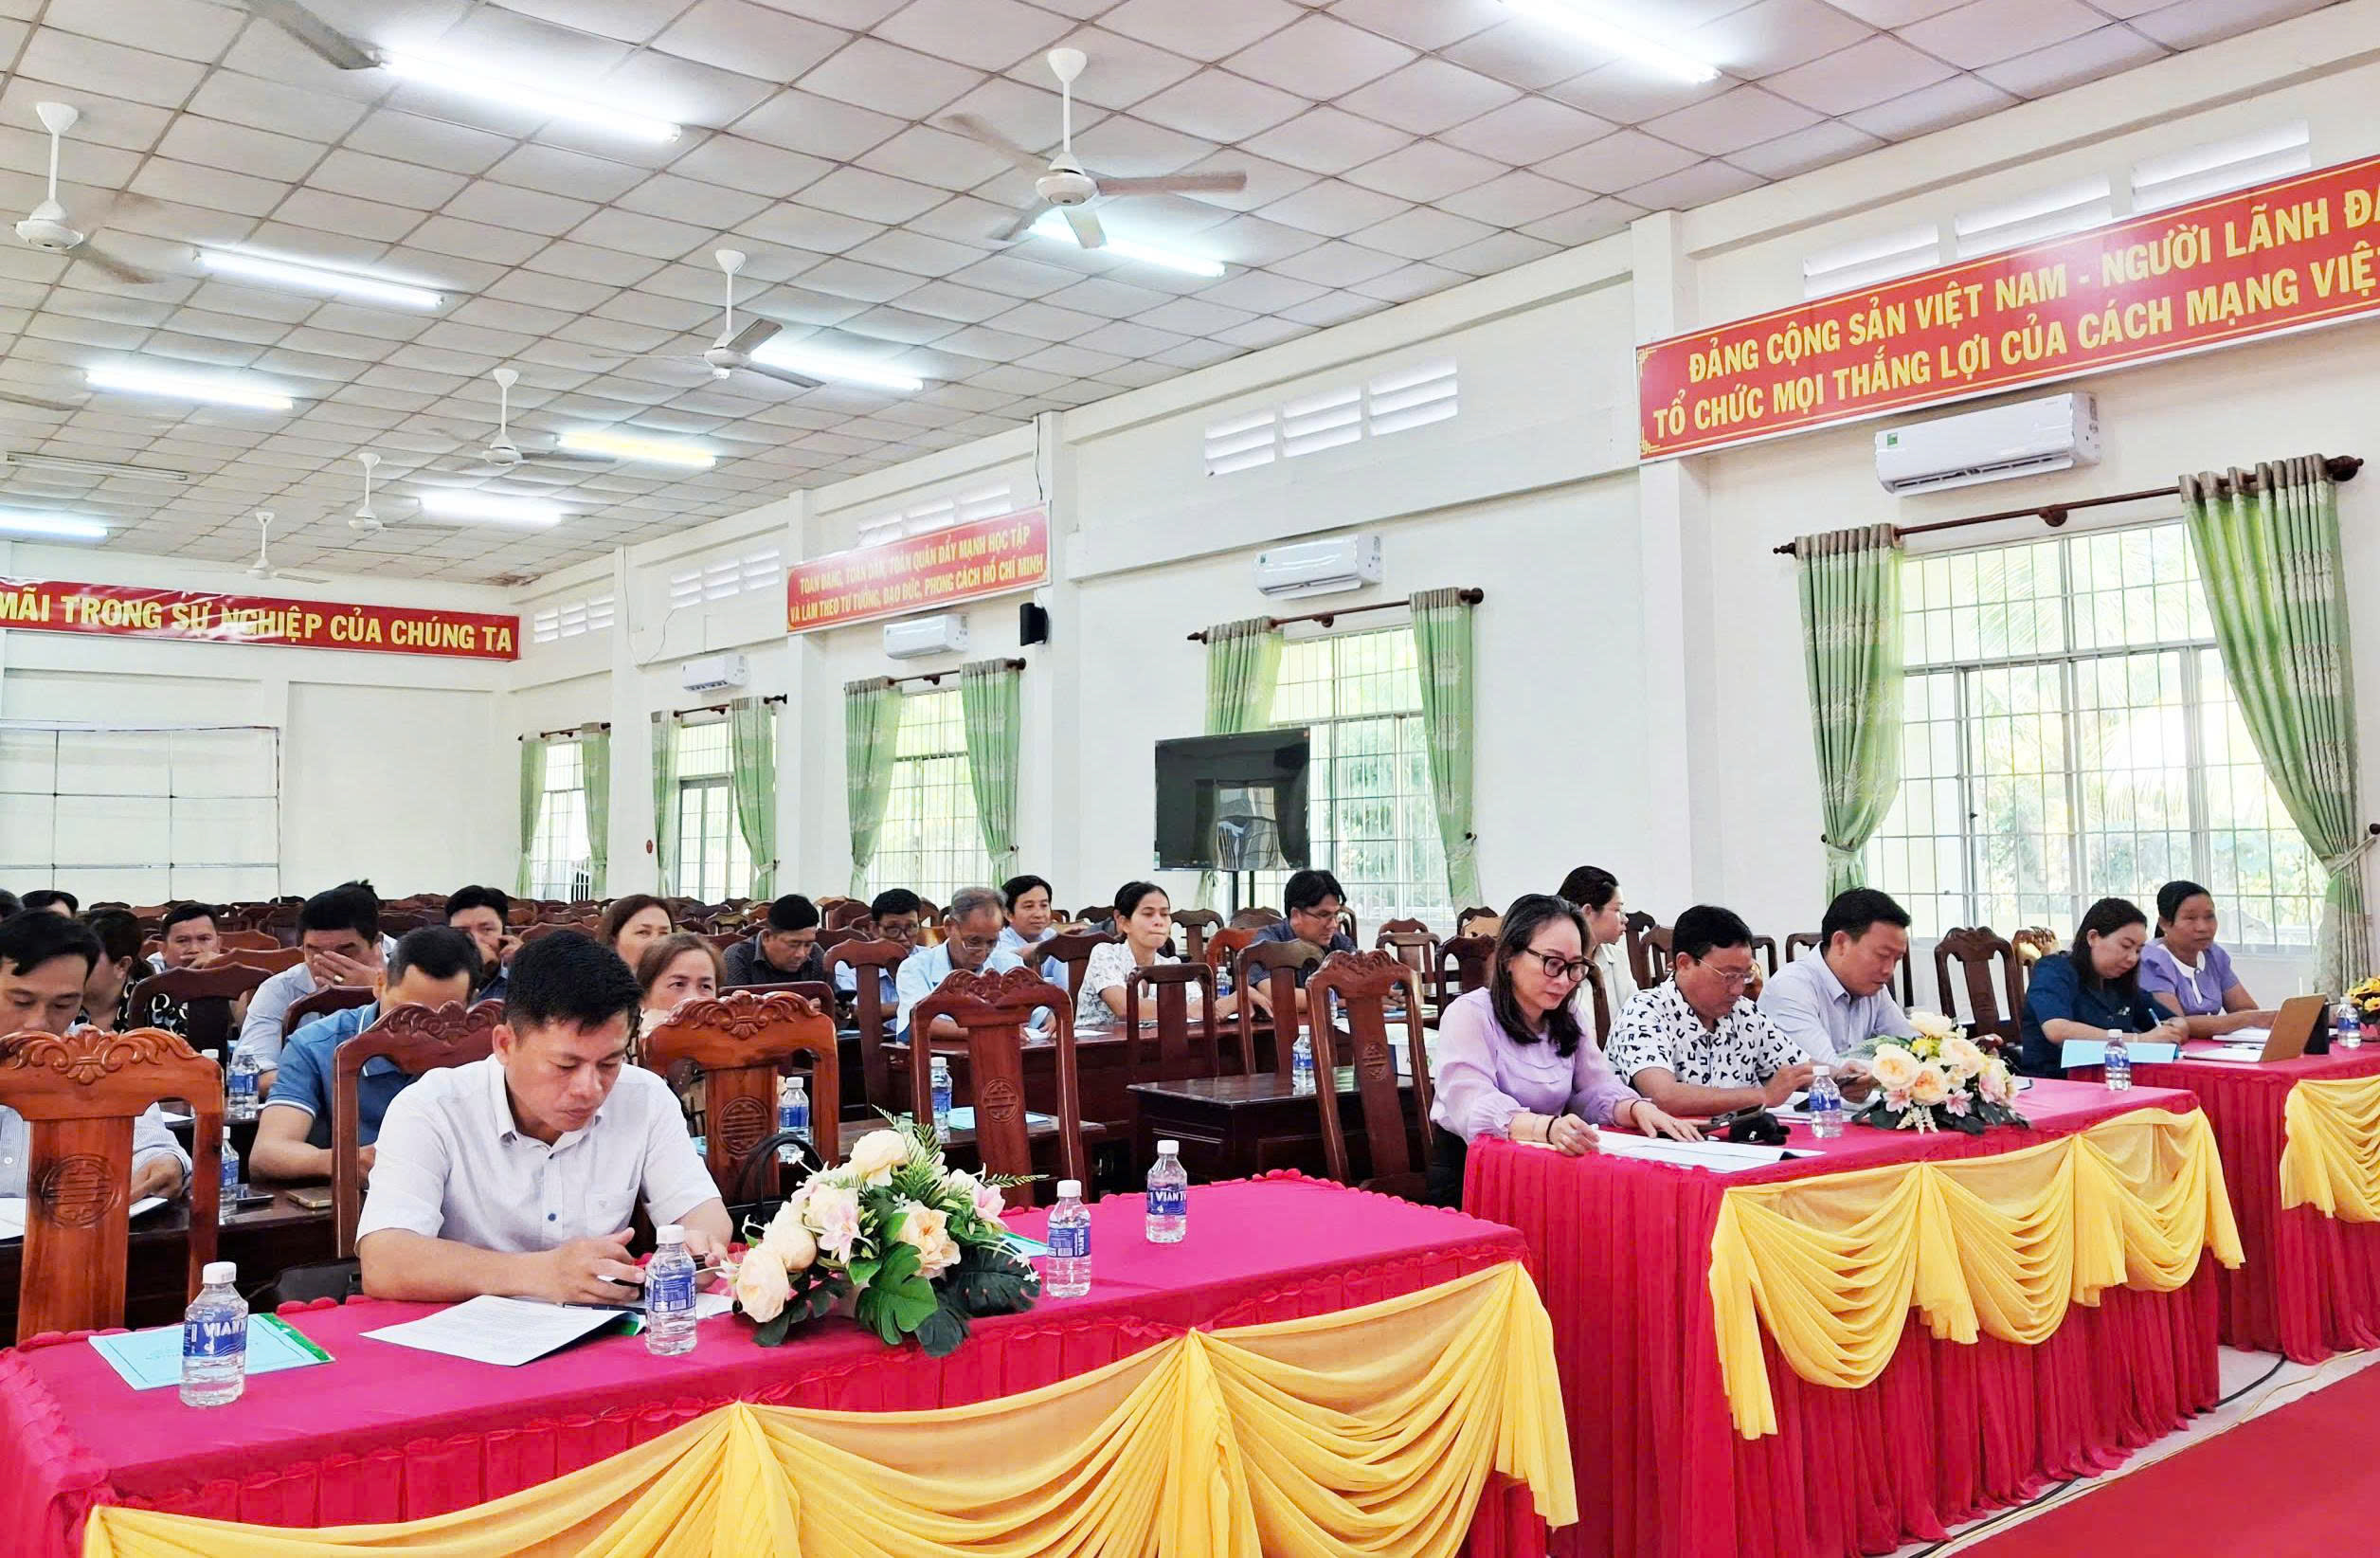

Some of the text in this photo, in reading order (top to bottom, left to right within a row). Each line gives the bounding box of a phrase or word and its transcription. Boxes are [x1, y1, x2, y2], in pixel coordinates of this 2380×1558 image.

[1688, 336, 1759, 383] ĐẢNG
[1766, 321, 1841, 367] CỘNG
[1848, 296, 1906, 346] SẢN
[1914, 281, 1982, 330] VIỆT
[1994, 263, 2067, 312] NAM
[2101, 224, 2211, 287] NGƯỜI
[2225, 197, 2329, 259] LÃNH
[2344, 184, 2380, 229] Đ
[1652, 240, 2380, 440] TỔ CHỨC MỌI THẮNG LỢI CỦA CÁCH MẠNG VIỆ
[959, 534, 986, 562] MẠNH
[988, 530, 1009, 555] HỌC
[1010, 522, 1031, 550] TẬP
[819, 596, 839, 618] THEO
[925, 572, 954, 597] PHONG
[956, 564, 981, 589] CÁCH
[983, 555, 996, 584] HỒ
[999, 555, 1016, 582] CHÍ
[1018, 553, 1043, 577] MINH
[0, 586, 50, 622] MÃI
[61, 594, 163, 630] TRONG
[222, 604, 323, 643] NGHIỆP
[330, 607, 383, 643] CỦA
[389, 616, 476, 650] CHÚNG
[481, 625, 513, 652] TA
